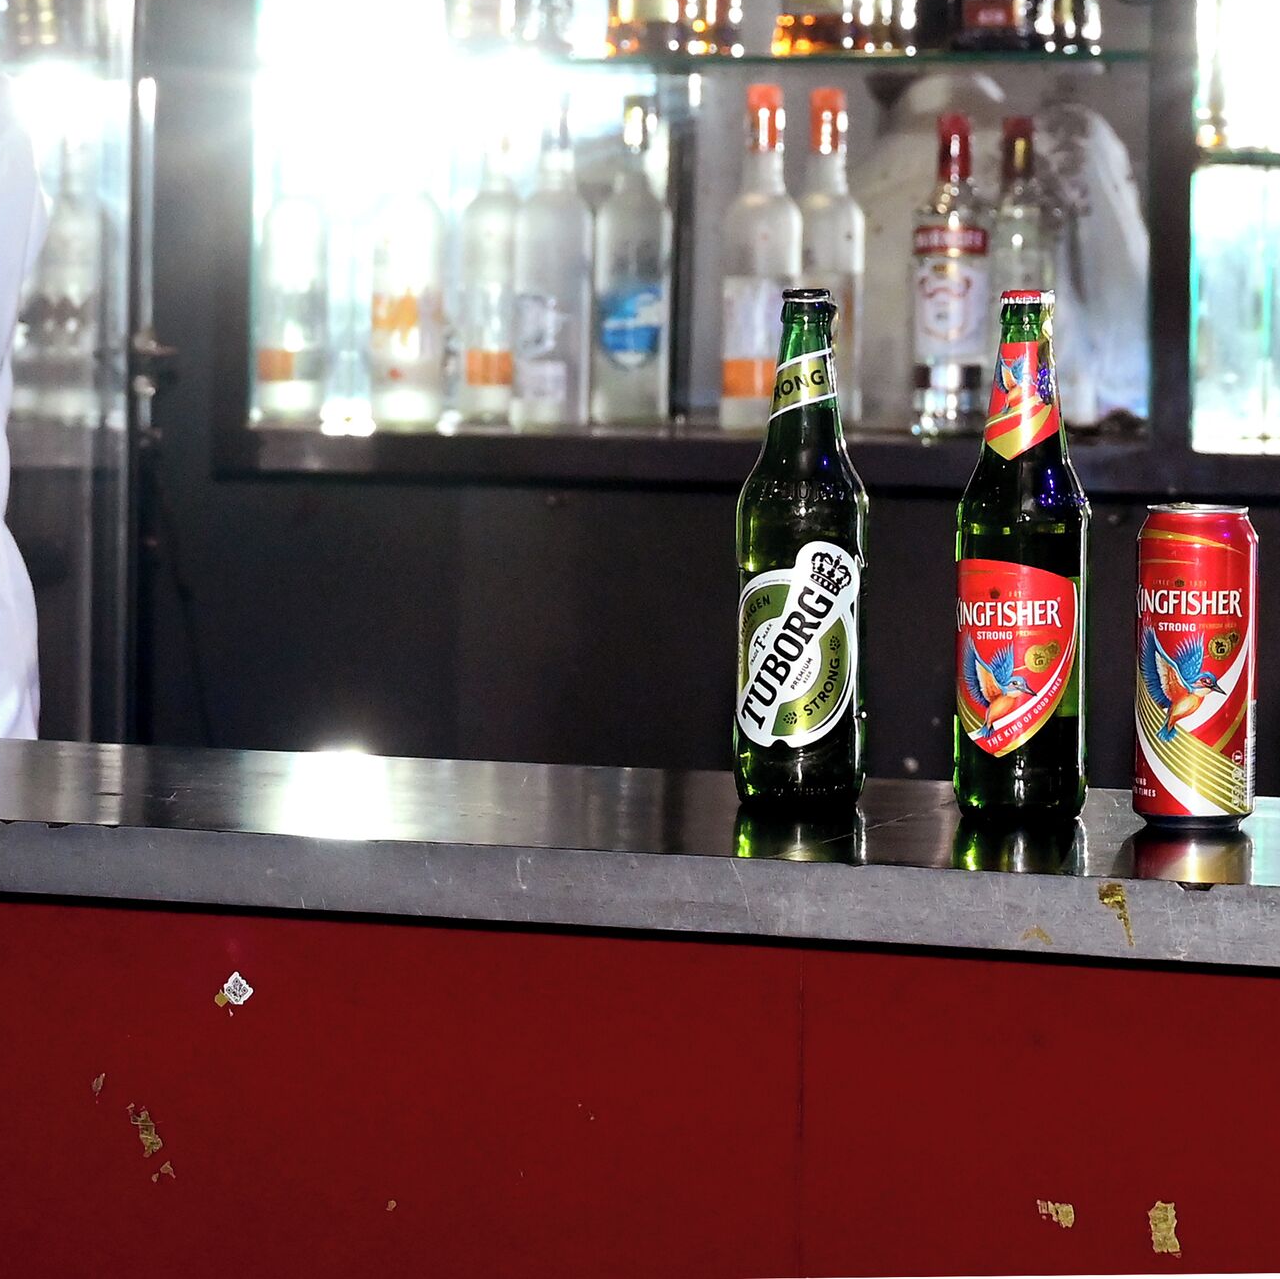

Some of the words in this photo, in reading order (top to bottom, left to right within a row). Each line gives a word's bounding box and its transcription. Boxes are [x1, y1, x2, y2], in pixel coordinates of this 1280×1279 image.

[976, 630, 1013, 640] STRONG
[1158, 622, 1197, 632] STRONG
[741, 586, 834, 731] TUBORG
[790, 657, 813, 690] PREMIUM
[803, 657, 840, 716] STRONG
[987, 733, 1003, 747] THE
[1003, 722, 1023, 741] KING
[1023, 713, 1034, 727] OF
[1033, 697, 1049, 716] GOOD
[1048, 677, 1063, 700] TIMES
